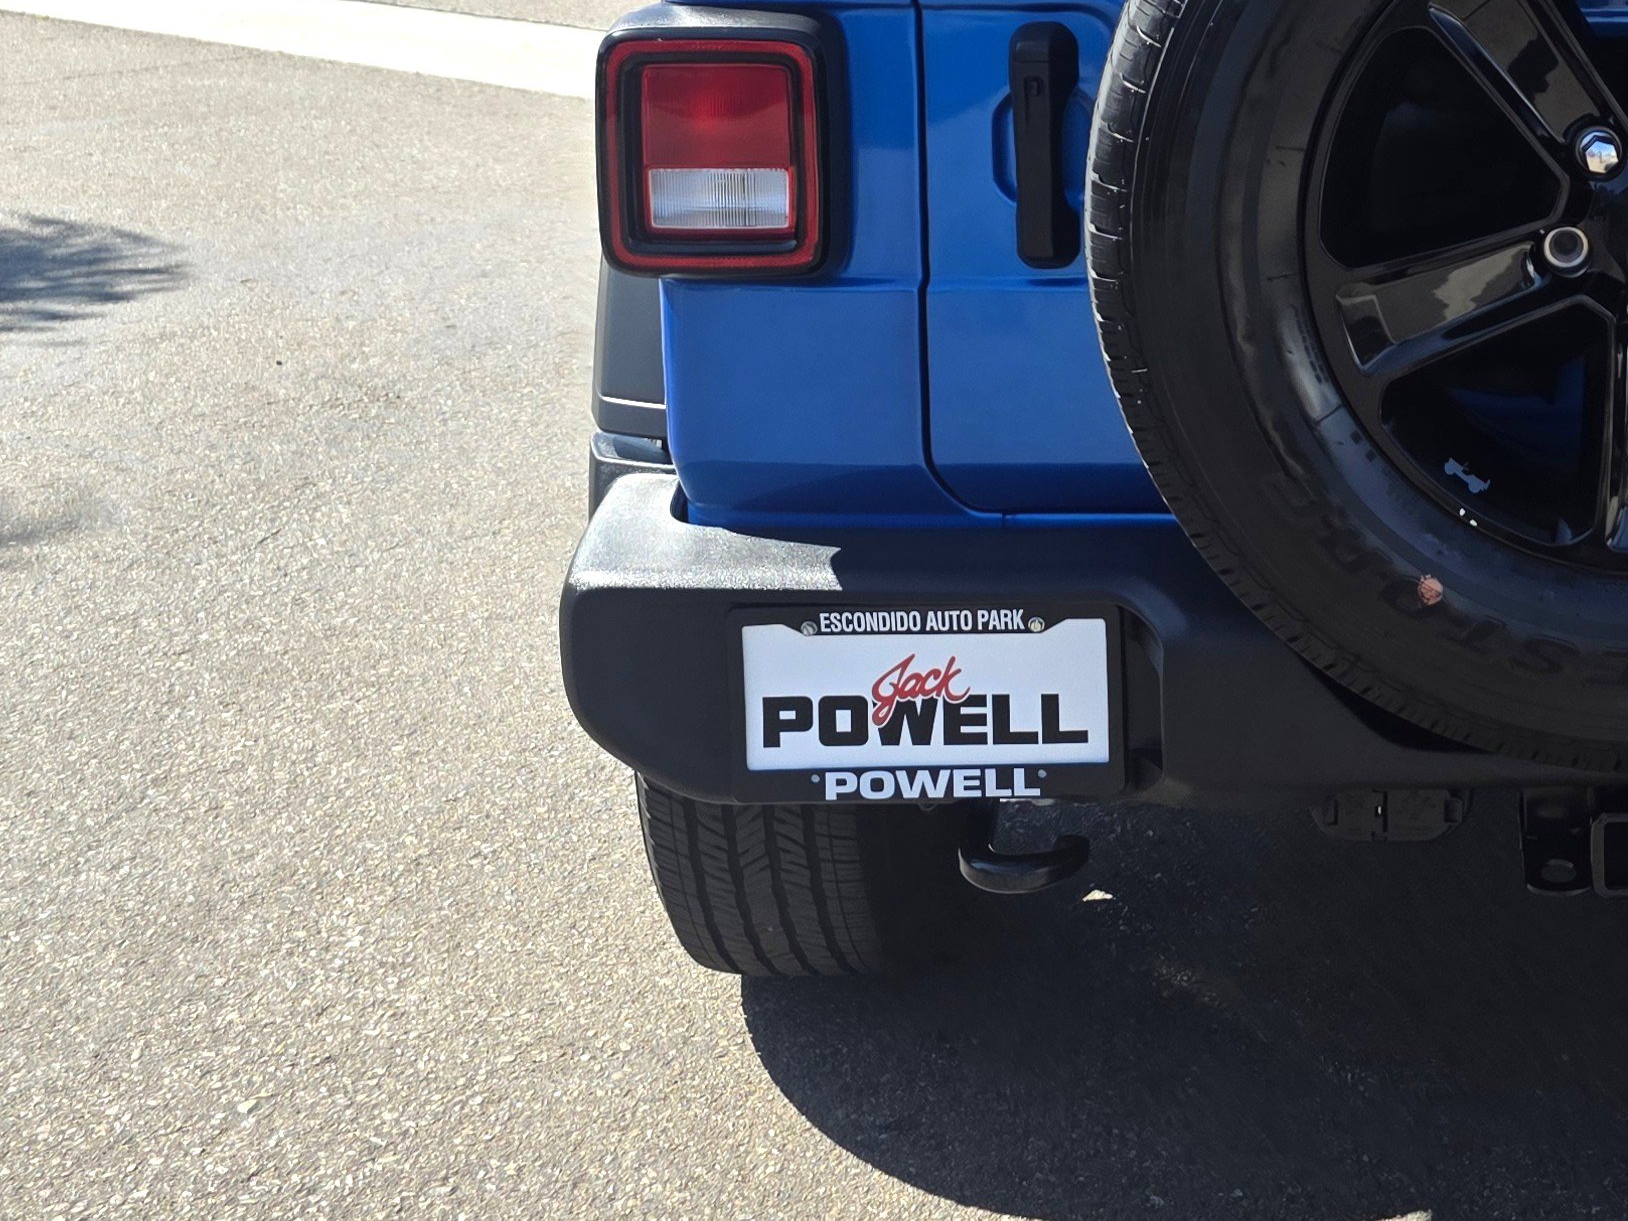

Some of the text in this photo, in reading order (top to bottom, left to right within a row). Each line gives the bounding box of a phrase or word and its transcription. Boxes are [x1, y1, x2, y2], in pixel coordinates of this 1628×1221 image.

[819, 609, 1024, 633] ESCONDIDO AUTO PARK
[871, 653, 970, 726] Jack
[762, 693, 1089, 748] POWELL
[825, 768, 1041, 800] POWELL
